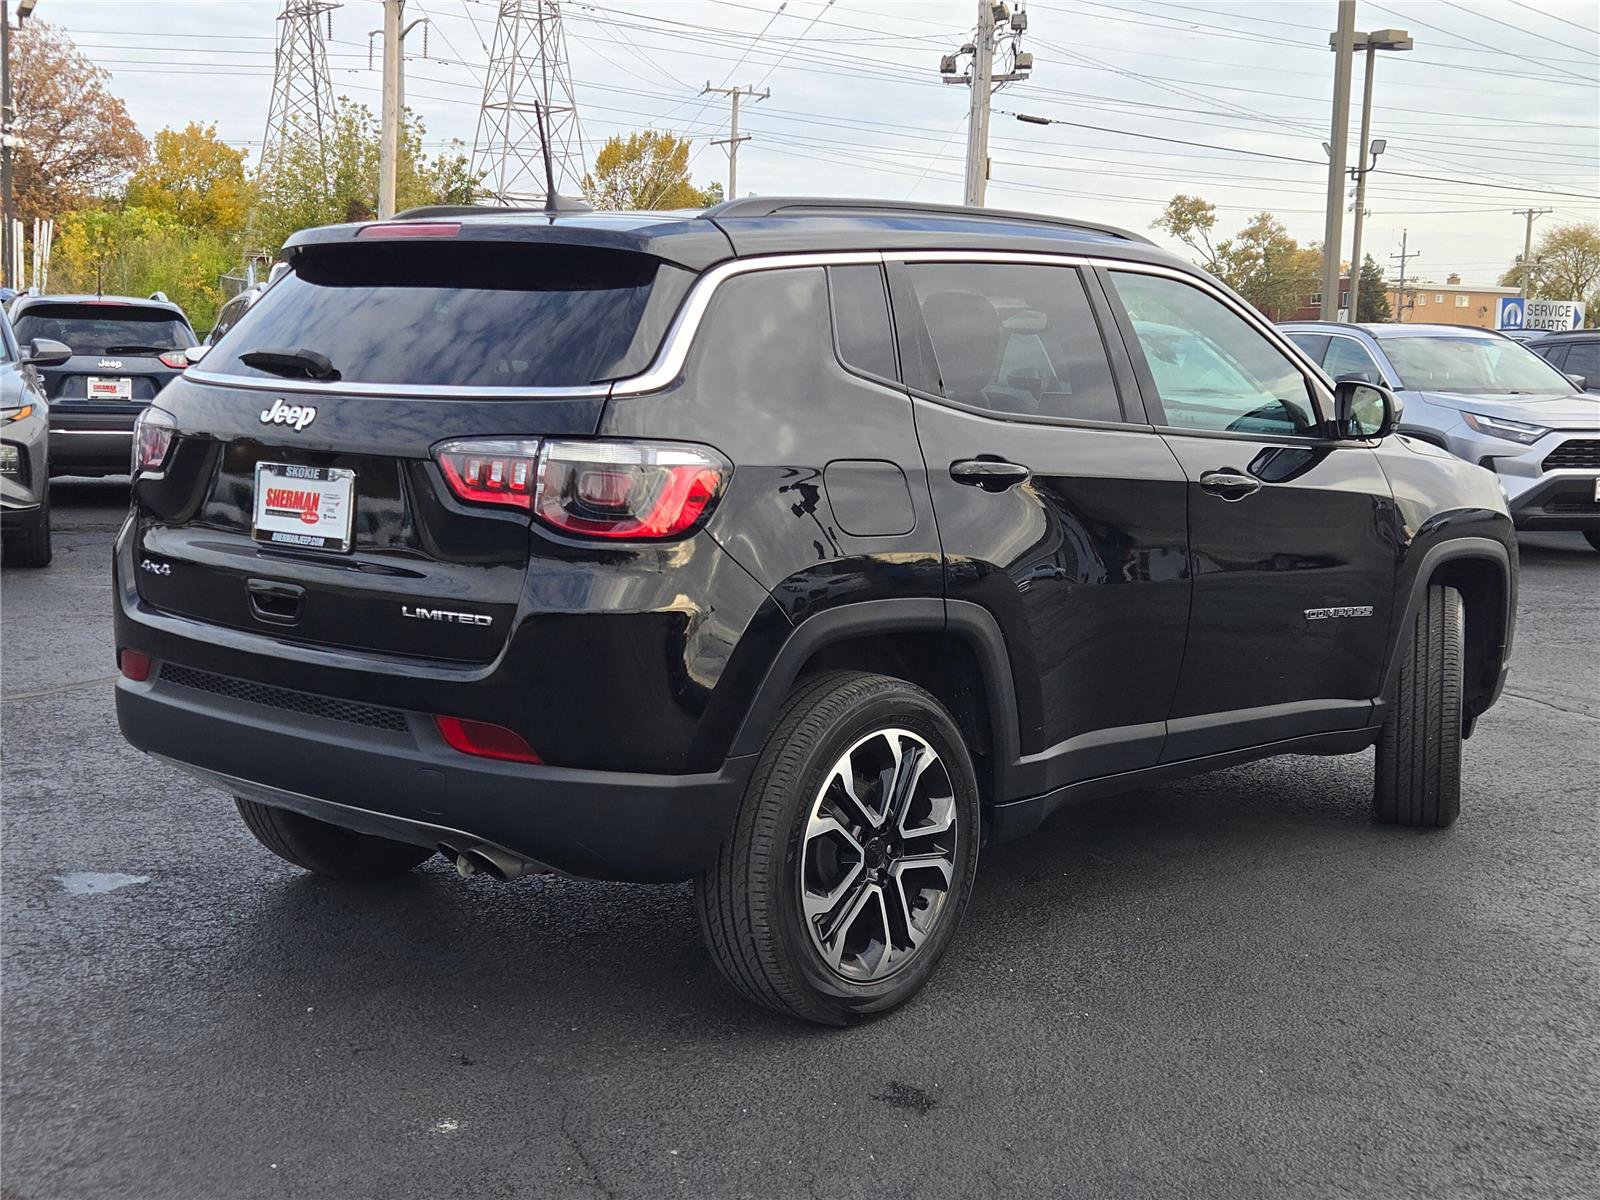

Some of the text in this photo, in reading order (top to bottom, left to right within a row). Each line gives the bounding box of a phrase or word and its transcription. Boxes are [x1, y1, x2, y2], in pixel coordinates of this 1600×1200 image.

[1527, 304, 1572, 317] SERVICE
[1526, 319, 1533, 329] &
[1534, 319, 1568, 330] PARTS
[98, 358, 122, 369] Jeep
[260, 399, 317, 431] Jeep
[286, 466, 320, 479] SKOKIE
[266, 488, 320, 512] SHERMAN
[402, 606, 492, 626] LIMITED
[1304, 606, 1373, 620] COMPASS
